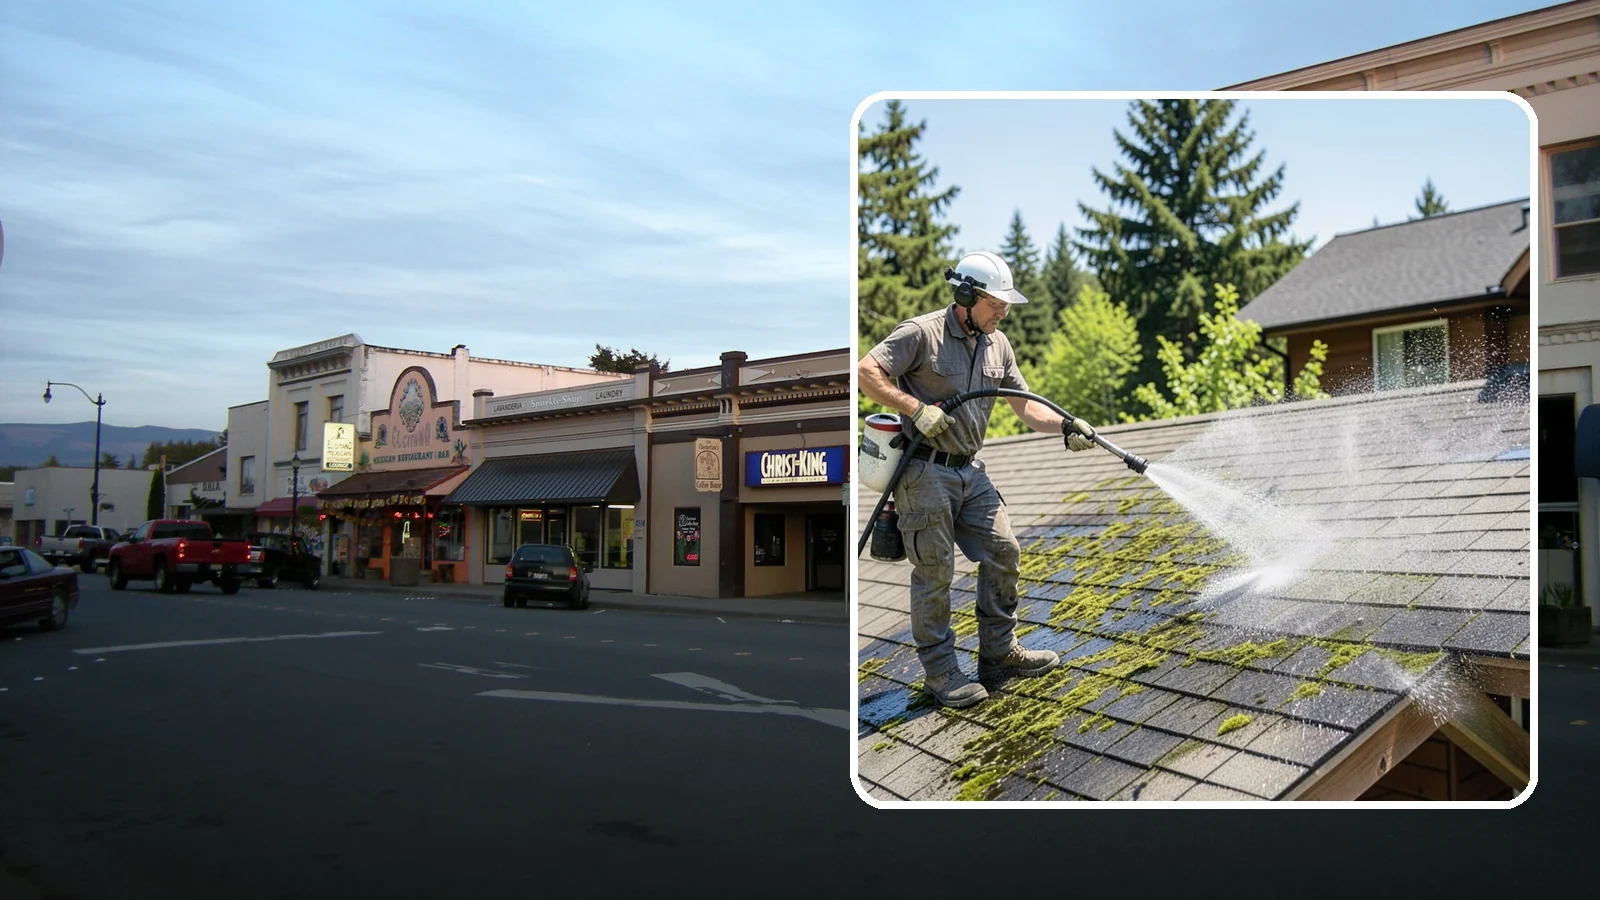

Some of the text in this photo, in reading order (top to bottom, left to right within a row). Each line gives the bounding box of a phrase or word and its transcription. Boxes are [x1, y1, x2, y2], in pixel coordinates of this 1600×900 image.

[595, 389, 623, 400] LAUNDRY
[493, 402, 523, 412] LAVANDERIA
[531, 394, 583, 409] Sparkle Shop
[373, 454, 396, 464] MEXICAN
[397, 451, 433, 462] RESTAURANT
[437, 450, 450, 459] BAR
[761, 450, 827, 478] CHRIST KING
[696, 480, 709, 489] Coffee
